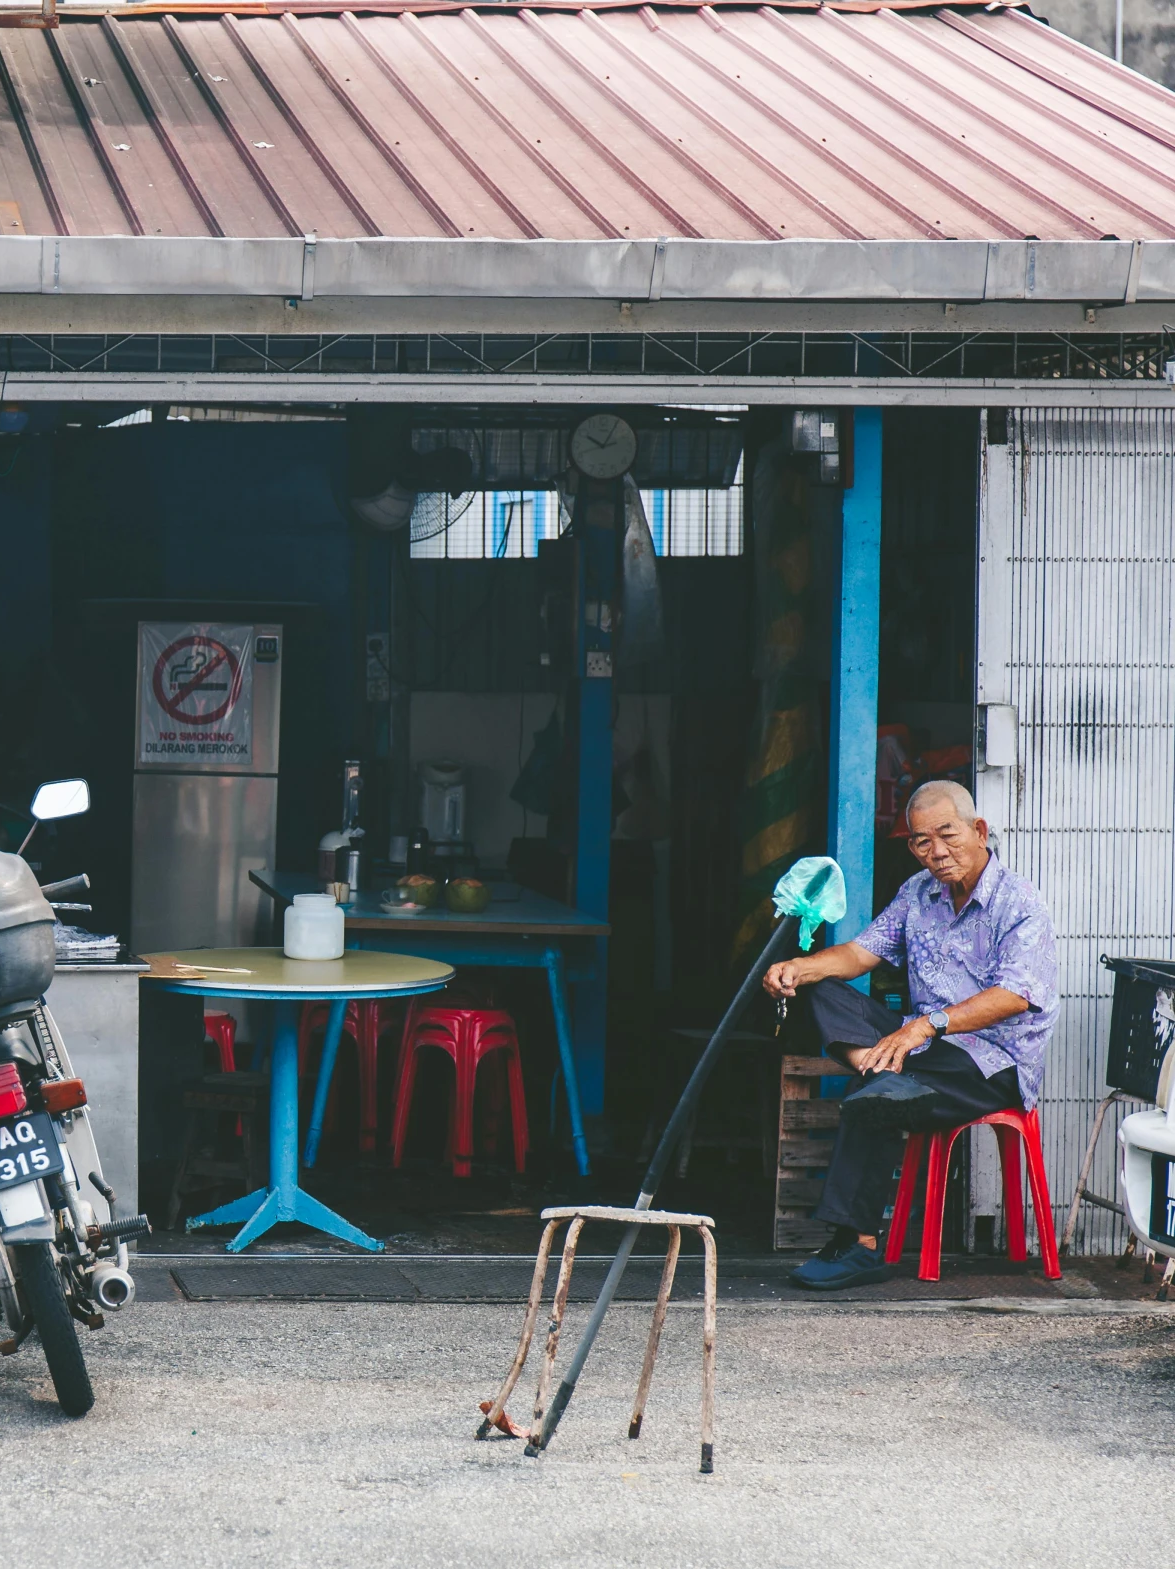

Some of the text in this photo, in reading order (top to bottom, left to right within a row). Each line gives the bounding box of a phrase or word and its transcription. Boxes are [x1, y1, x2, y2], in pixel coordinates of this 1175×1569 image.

[159, 731, 235, 742] NO SMOKING
[145, 743, 248, 754] DILARANG MEROKOK
